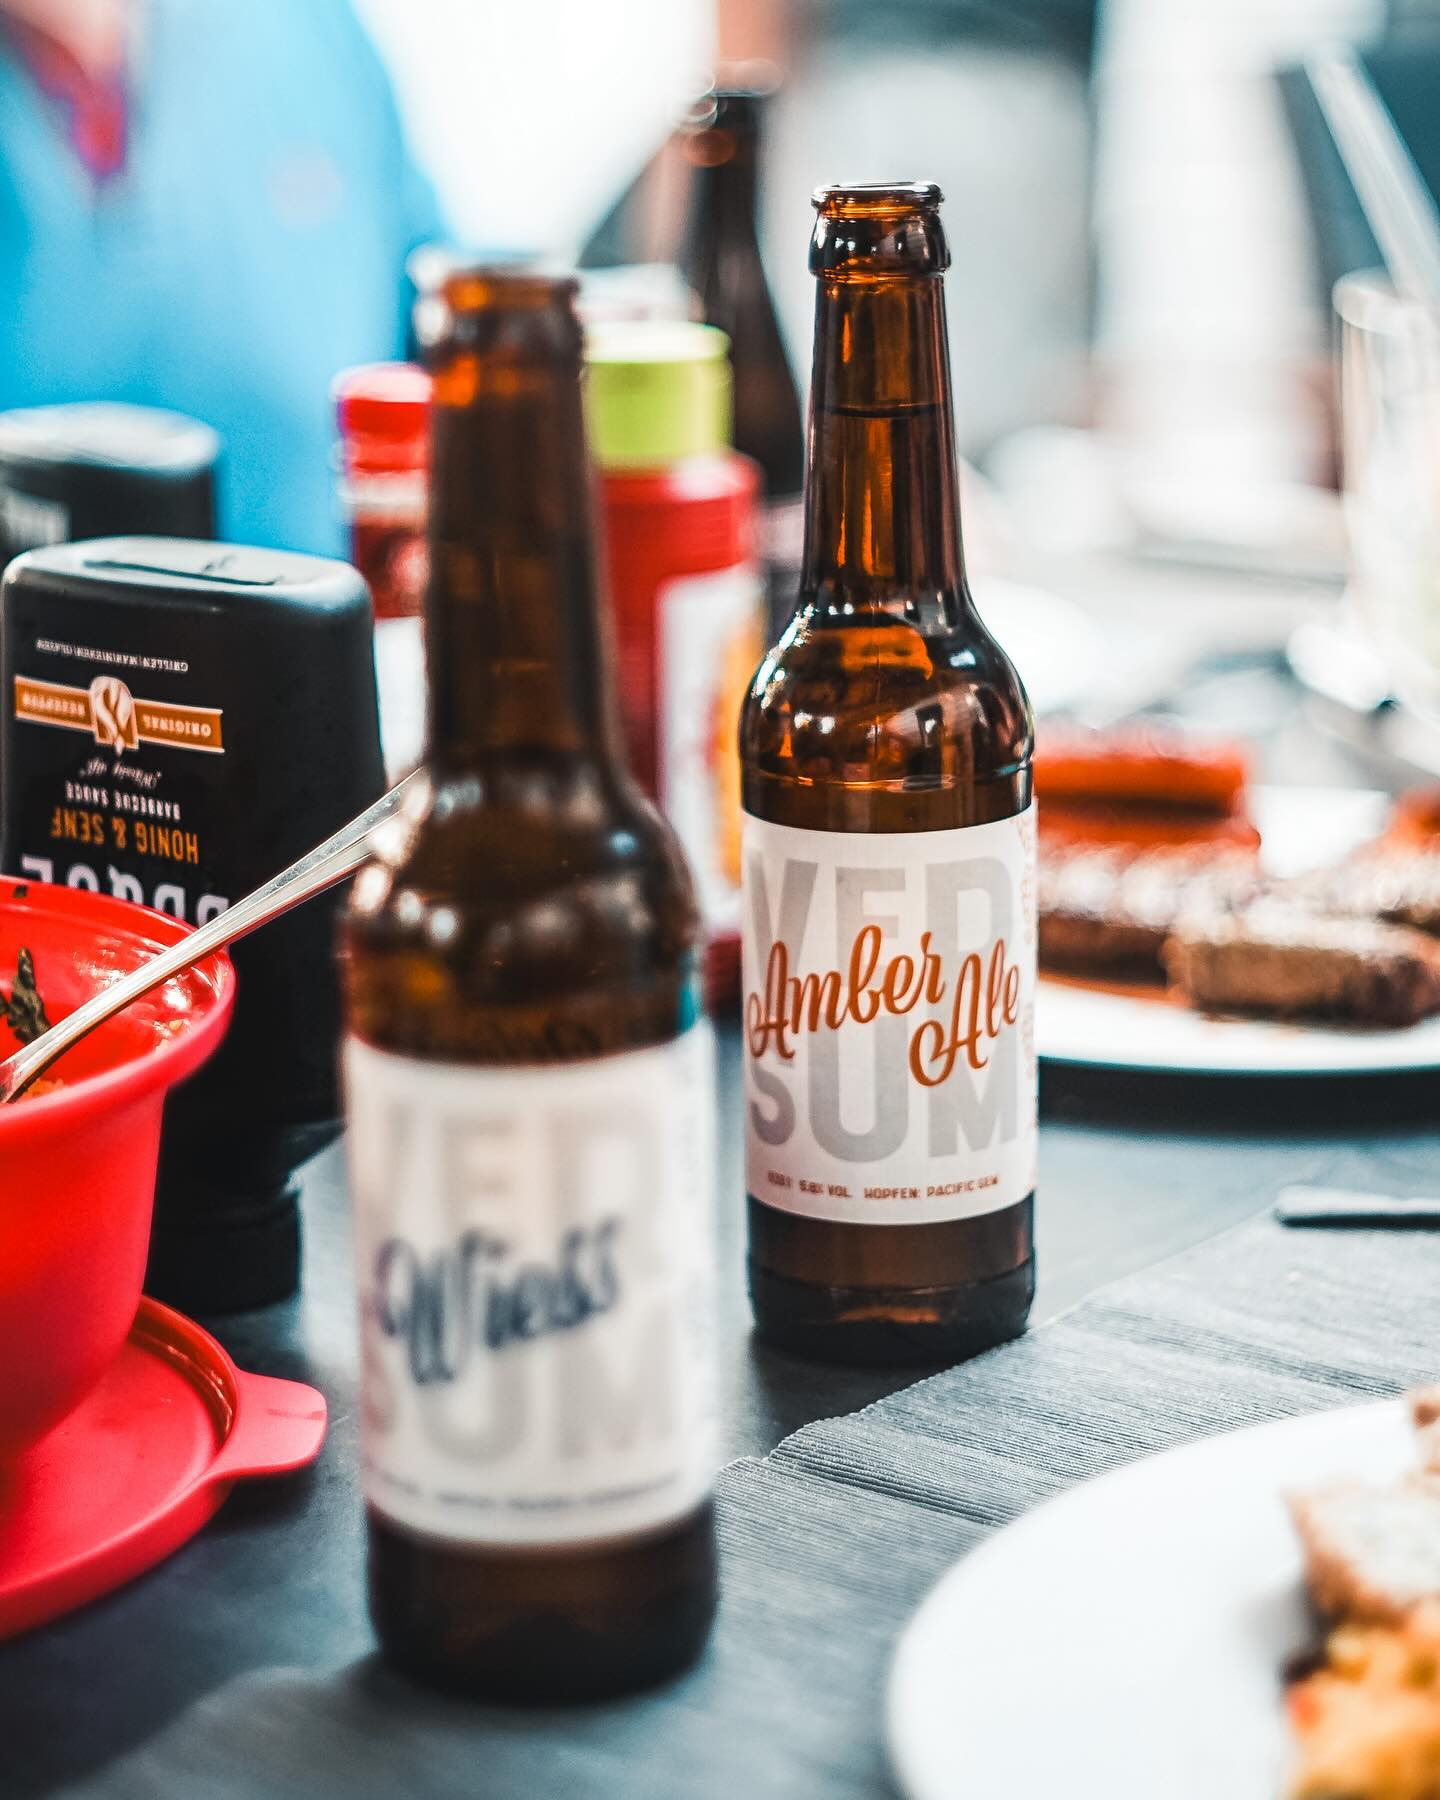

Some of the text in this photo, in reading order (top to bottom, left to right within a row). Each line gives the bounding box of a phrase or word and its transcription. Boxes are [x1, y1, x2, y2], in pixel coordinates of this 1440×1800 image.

[142, 656, 189, 673] GRILLEN
[143, 715, 212, 737] ORIGINAL
[50, 805, 199, 864] HONIG & SENF
[747, 924, 946, 1059] Amber
[909, 938, 1019, 1087] Ale
[927, 1179, 974, 1197] PACIFIC
